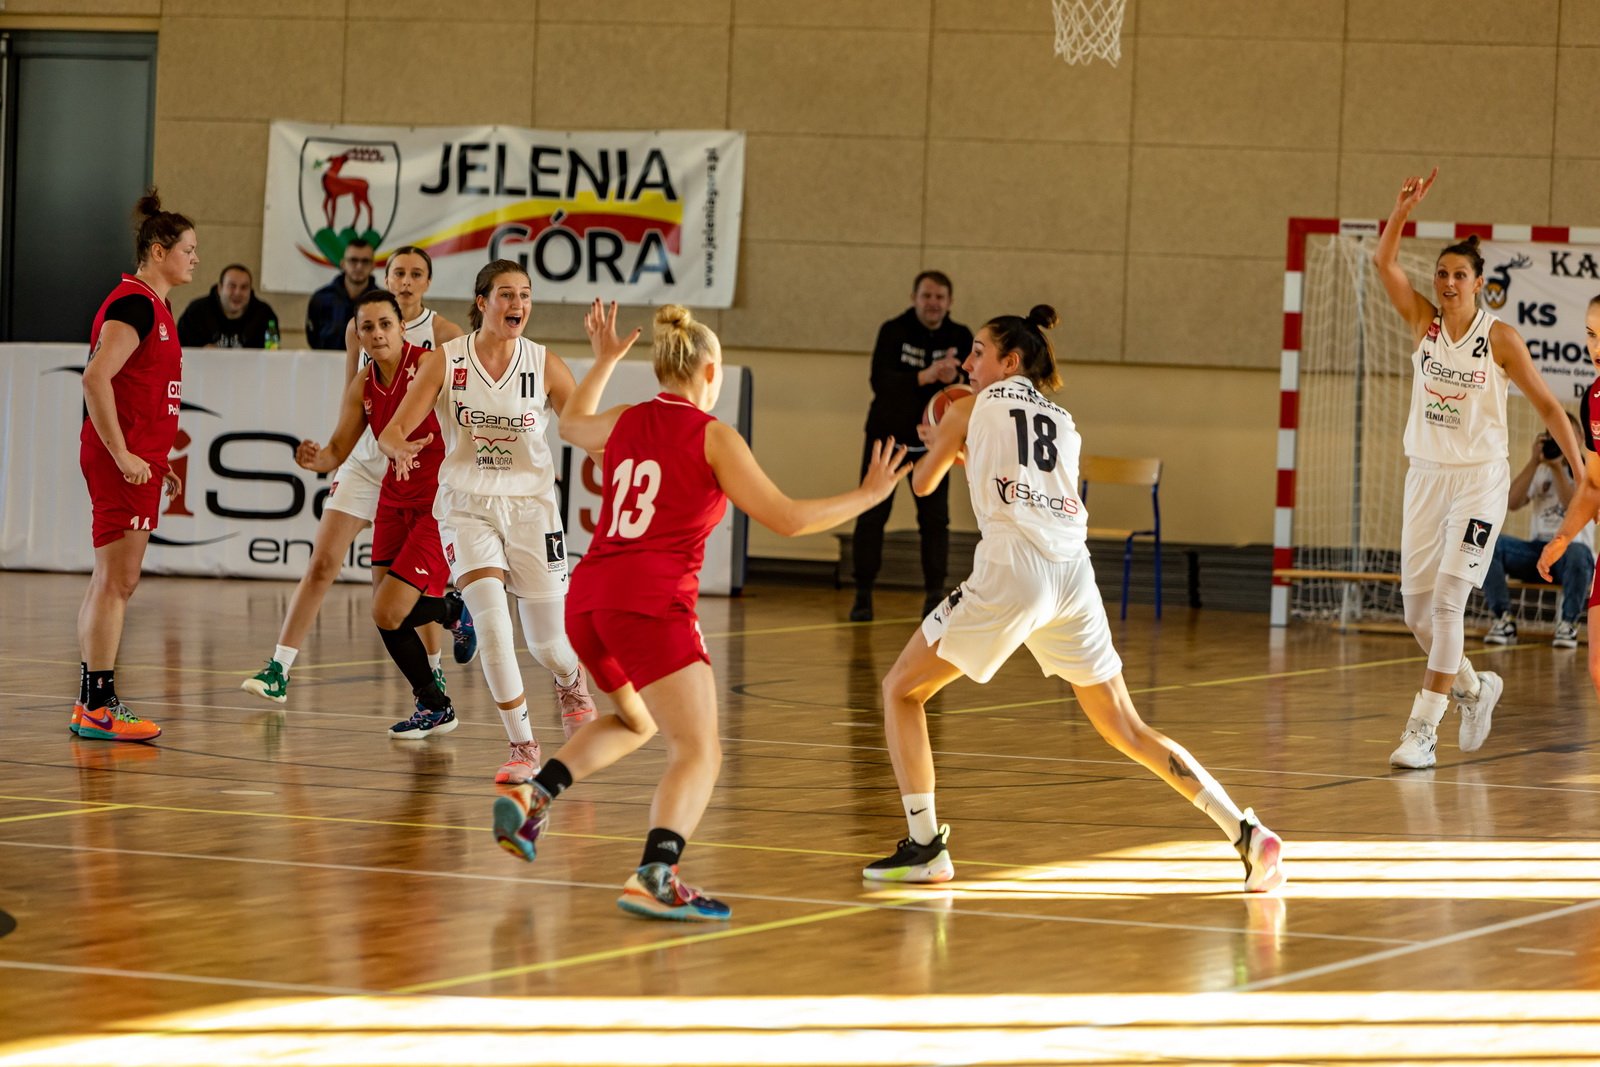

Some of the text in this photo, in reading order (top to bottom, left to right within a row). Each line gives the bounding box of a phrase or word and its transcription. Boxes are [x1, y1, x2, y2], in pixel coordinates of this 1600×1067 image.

[419, 142, 678, 202] JELENIA
[488, 209, 676, 285] GÓRA
[1518, 301, 1556, 327] KS
[520, 372, 535, 398] 11
[1426, 360, 1486, 384] iSandS
[464, 410, 536, 428] iSandS
[1009, 408, 1058, 473] 18
[606, 458, 662, 539] 13
[1011, 483, 1078, 515] iSandS
